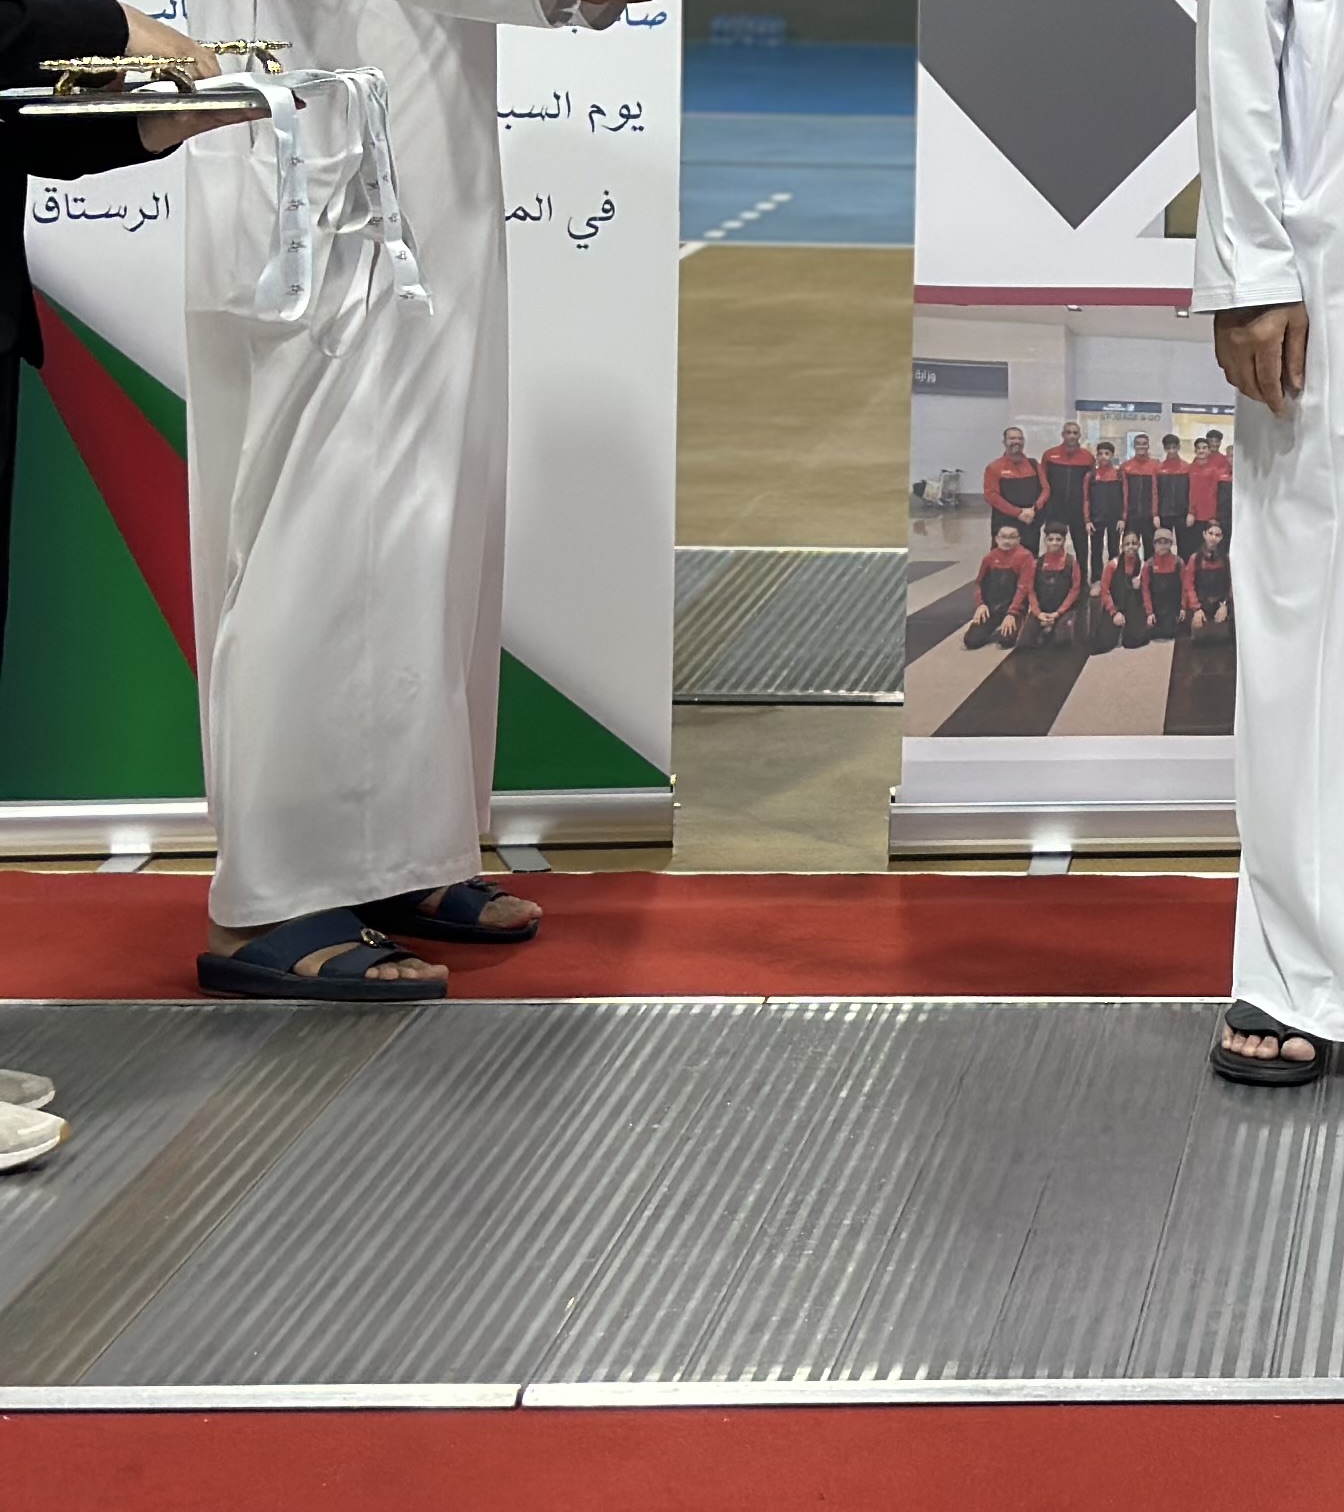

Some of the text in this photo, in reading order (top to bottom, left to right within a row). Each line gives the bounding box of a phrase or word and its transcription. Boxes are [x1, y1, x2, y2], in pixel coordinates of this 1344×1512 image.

[497, 91, 644, 132] يوم السب
[33, 187, 169, 232] الرستاق
[568, 190, 615, 249] في
